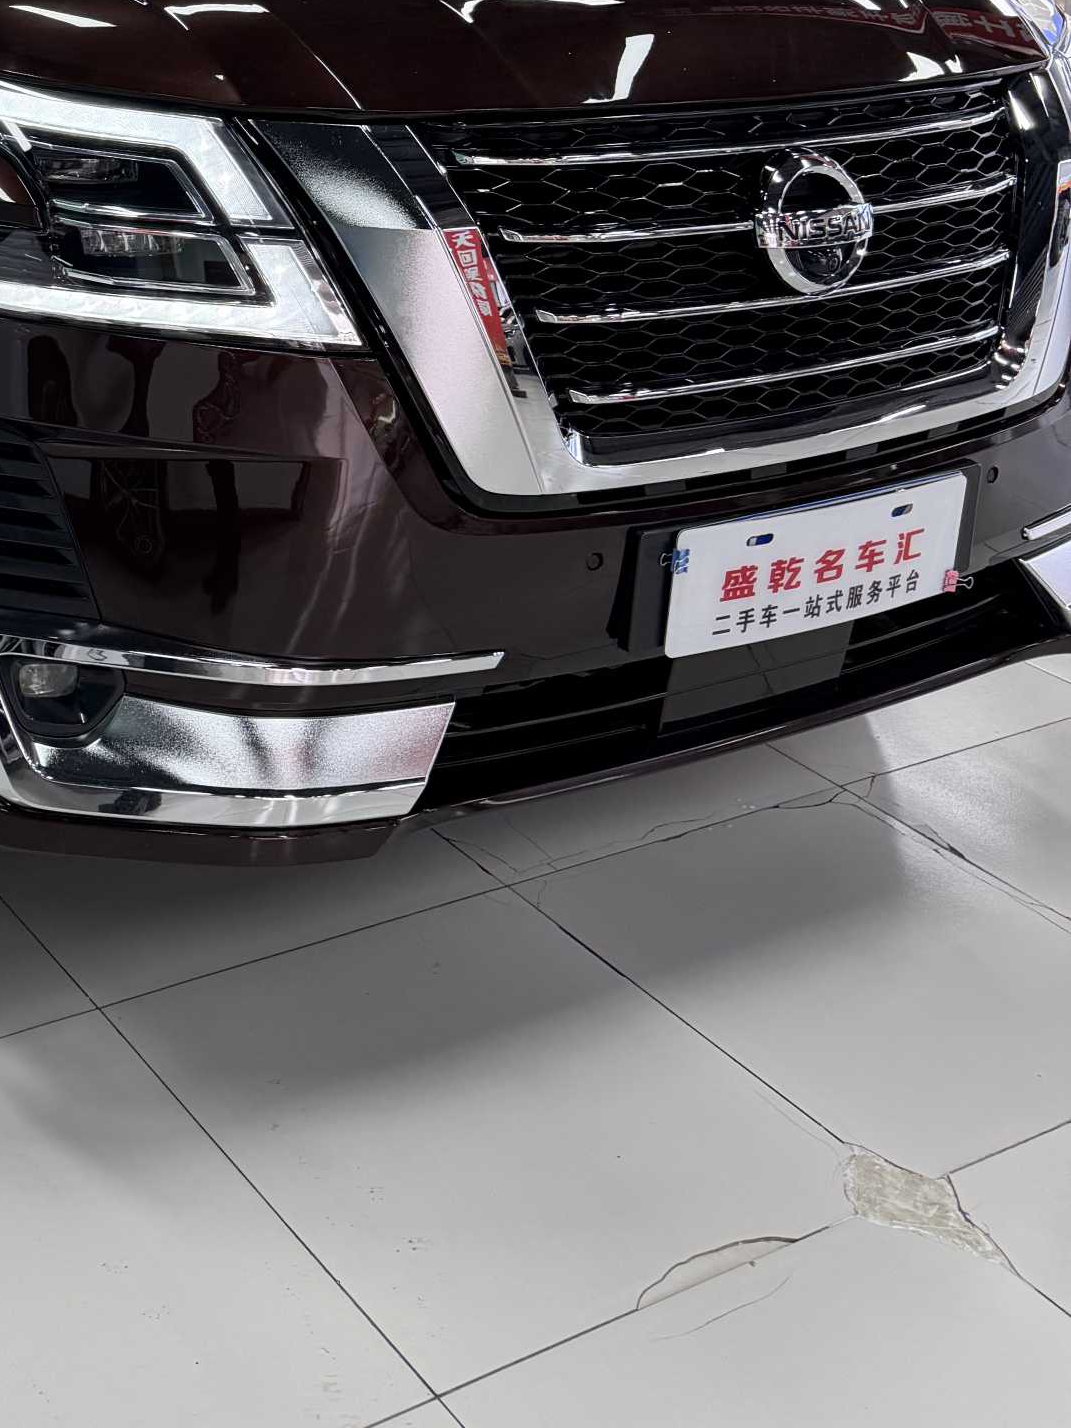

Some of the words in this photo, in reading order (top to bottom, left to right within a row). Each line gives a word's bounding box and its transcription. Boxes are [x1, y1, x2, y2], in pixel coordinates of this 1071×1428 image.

[779, 205, 872, 243] NISSAN
[719, 527, 925, 602] 盛乾名车汇
[712, 569, 920, 636] 二手车一站式服务平台
